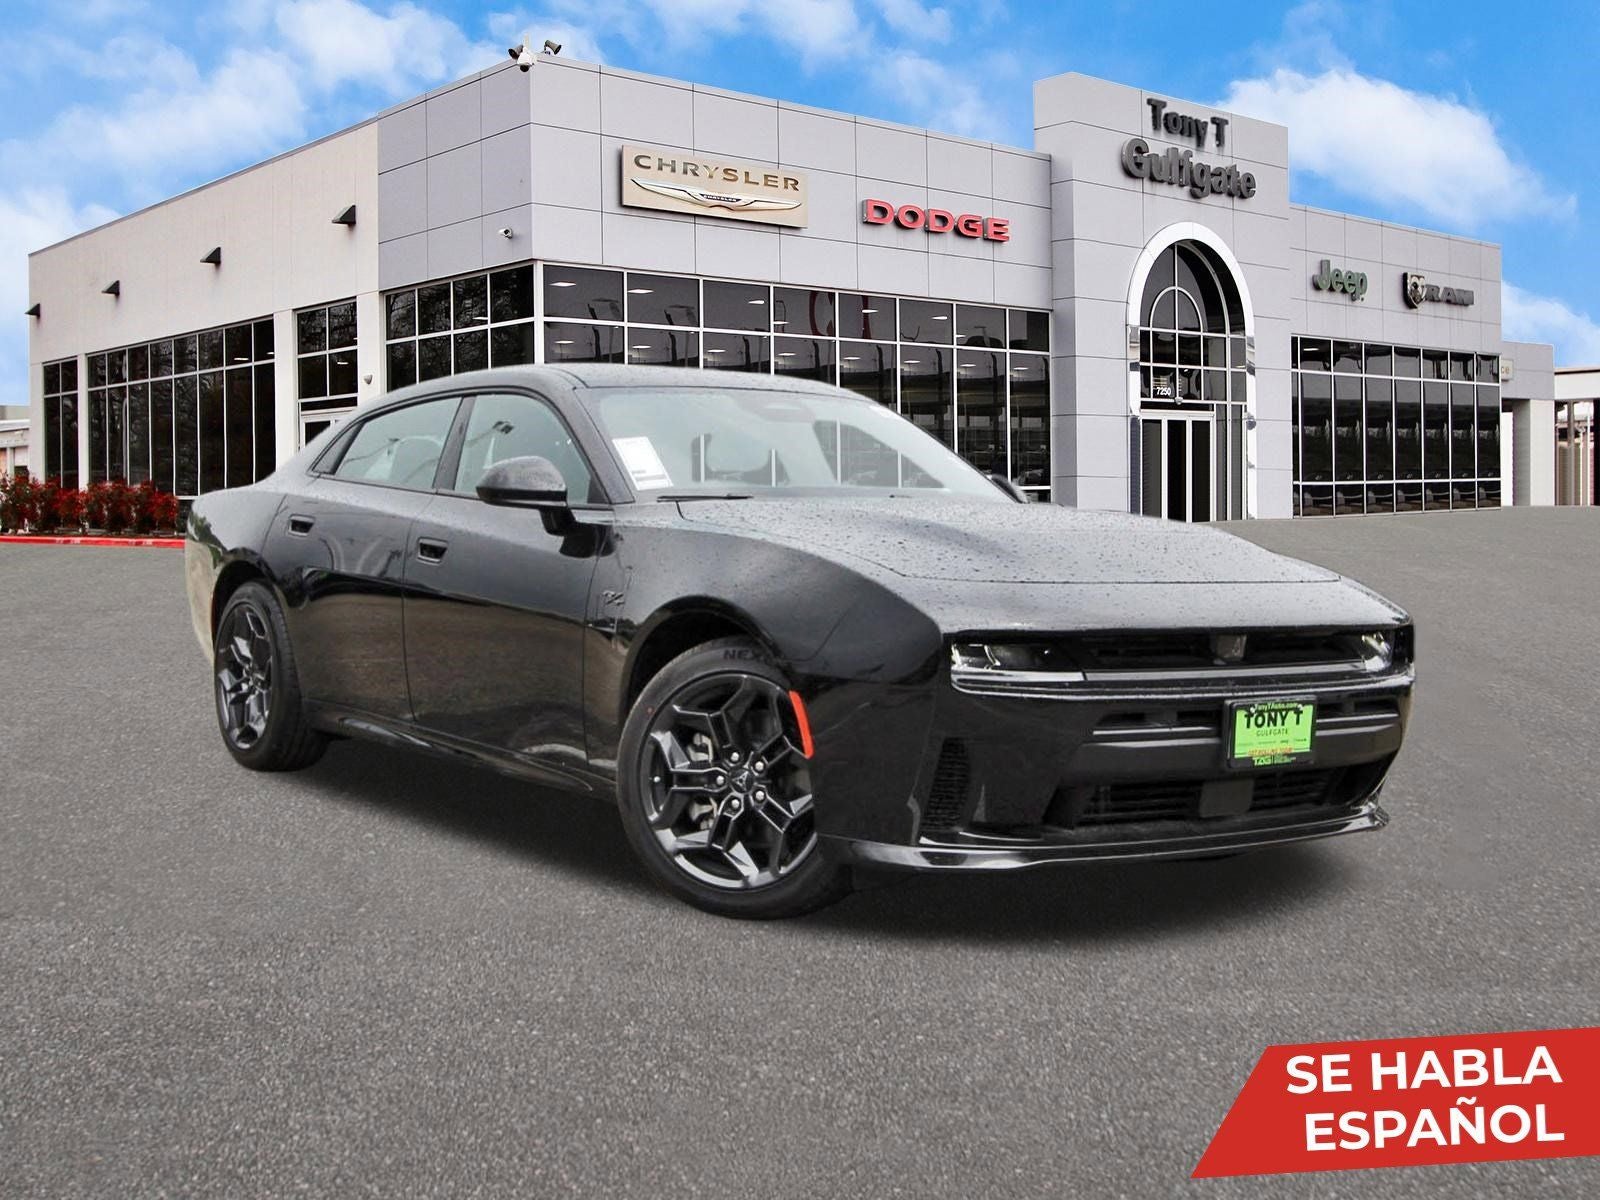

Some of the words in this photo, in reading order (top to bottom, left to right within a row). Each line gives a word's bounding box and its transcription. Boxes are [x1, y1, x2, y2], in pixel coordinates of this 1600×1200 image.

[1147, 98, 1208, 148] Tony
[1211, 117, 1229, 147] T
[633, 154, 800, 192] CHRYSLER
[1121, 138, 1256, 199] Gulfgate
[862, 198, 1010, 242] DODGE
[1312, 259, 1368, 302] Jeep
[1425, 284, 1474, 306] RAM
[1156, 386, 1172, 396] 7250
[1244, 709, 1289, 729] TONY
[1294, 708, 1303, 725] T
